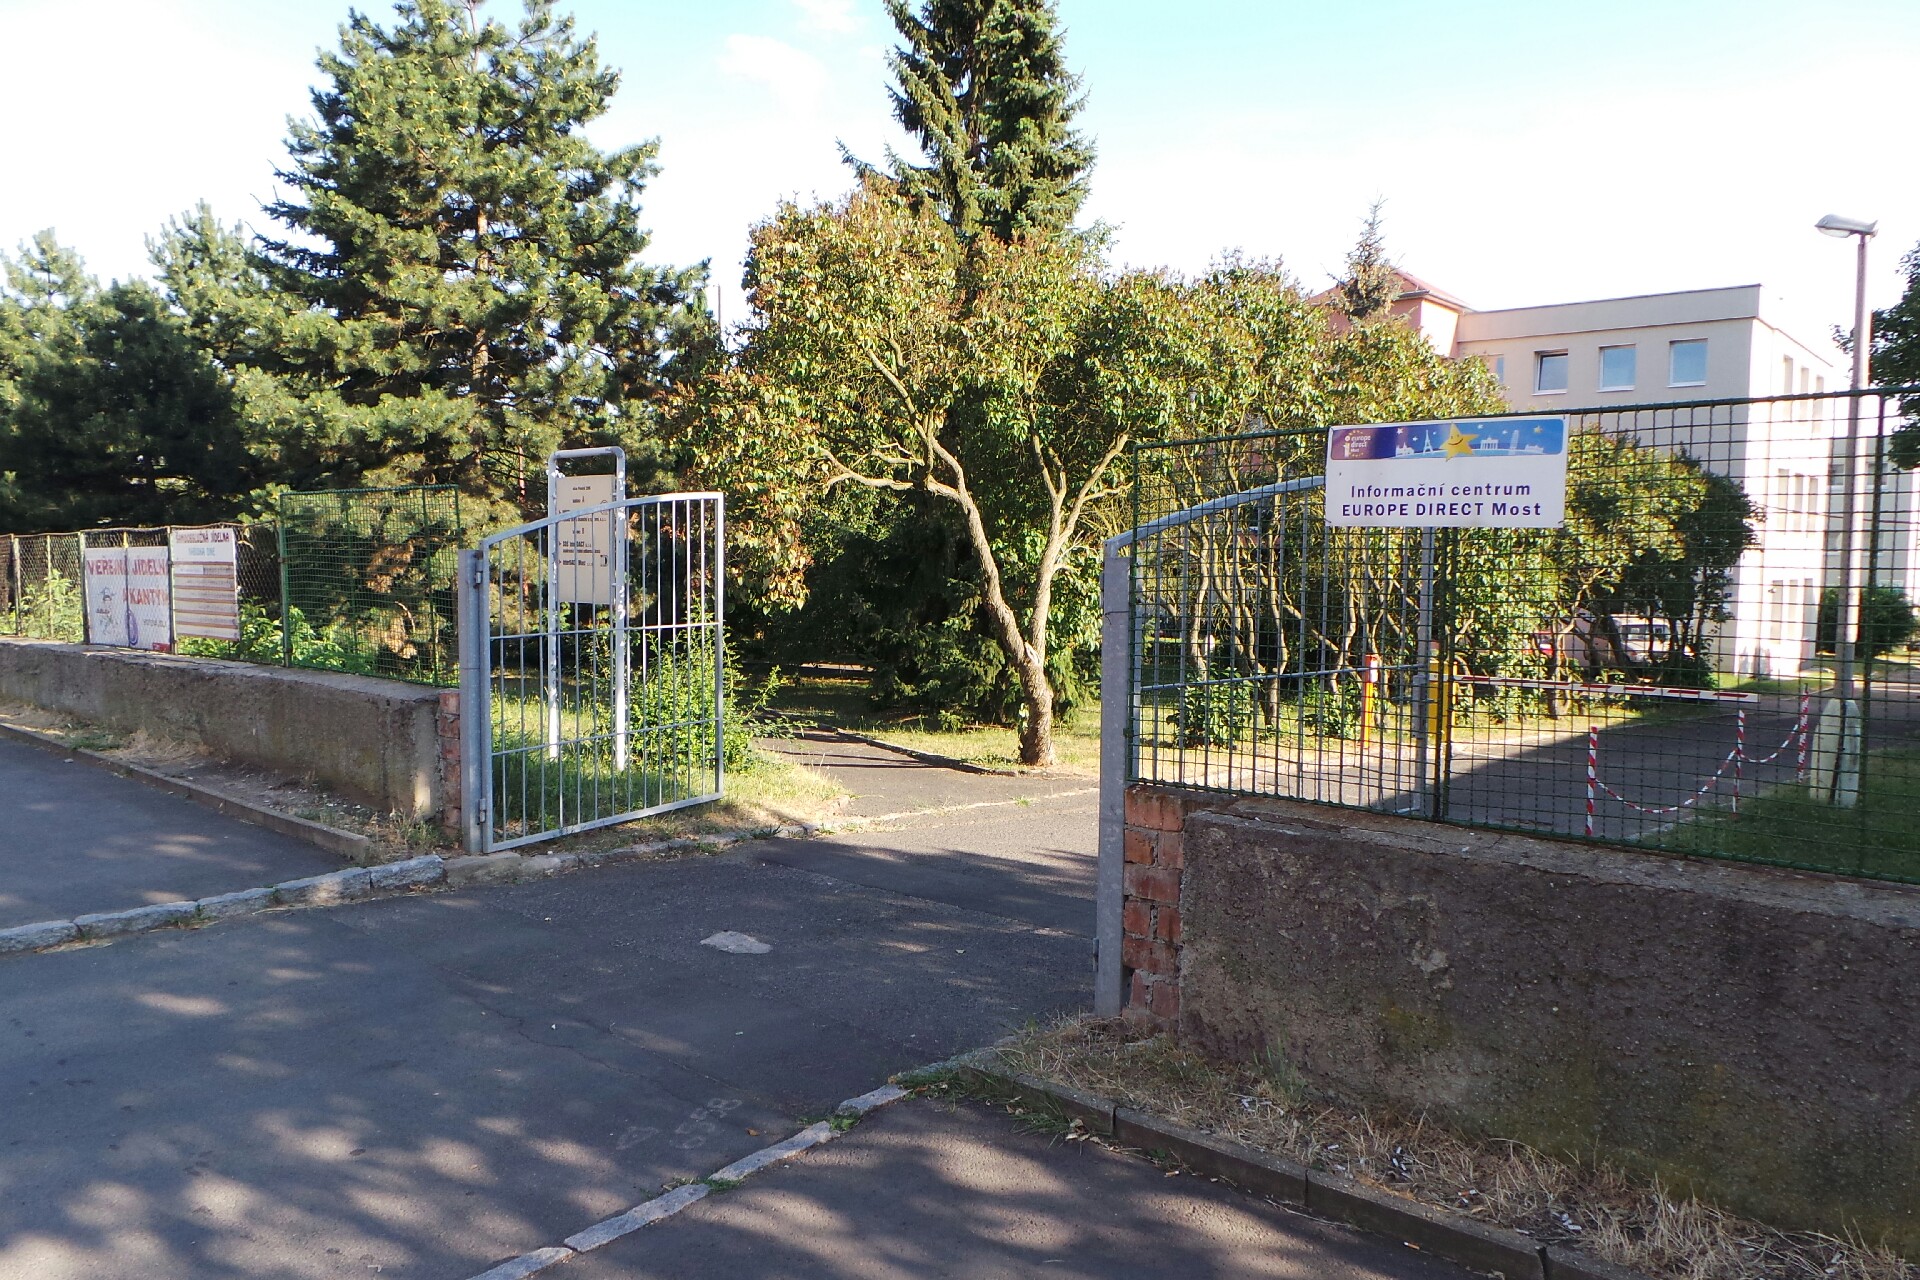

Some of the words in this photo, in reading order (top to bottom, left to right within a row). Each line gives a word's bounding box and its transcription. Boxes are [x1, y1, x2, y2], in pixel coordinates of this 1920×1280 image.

[1351, 435, 1371, 443] europe
[1351, 482, 1445, 498] Informační
[1451, 484, 1531, 497] centrum
[1342, 503, 1409, 517] EUROPE
[1415, 502, 1484, 516] DIRECT
[1491, 501, 1542, 516] Most
